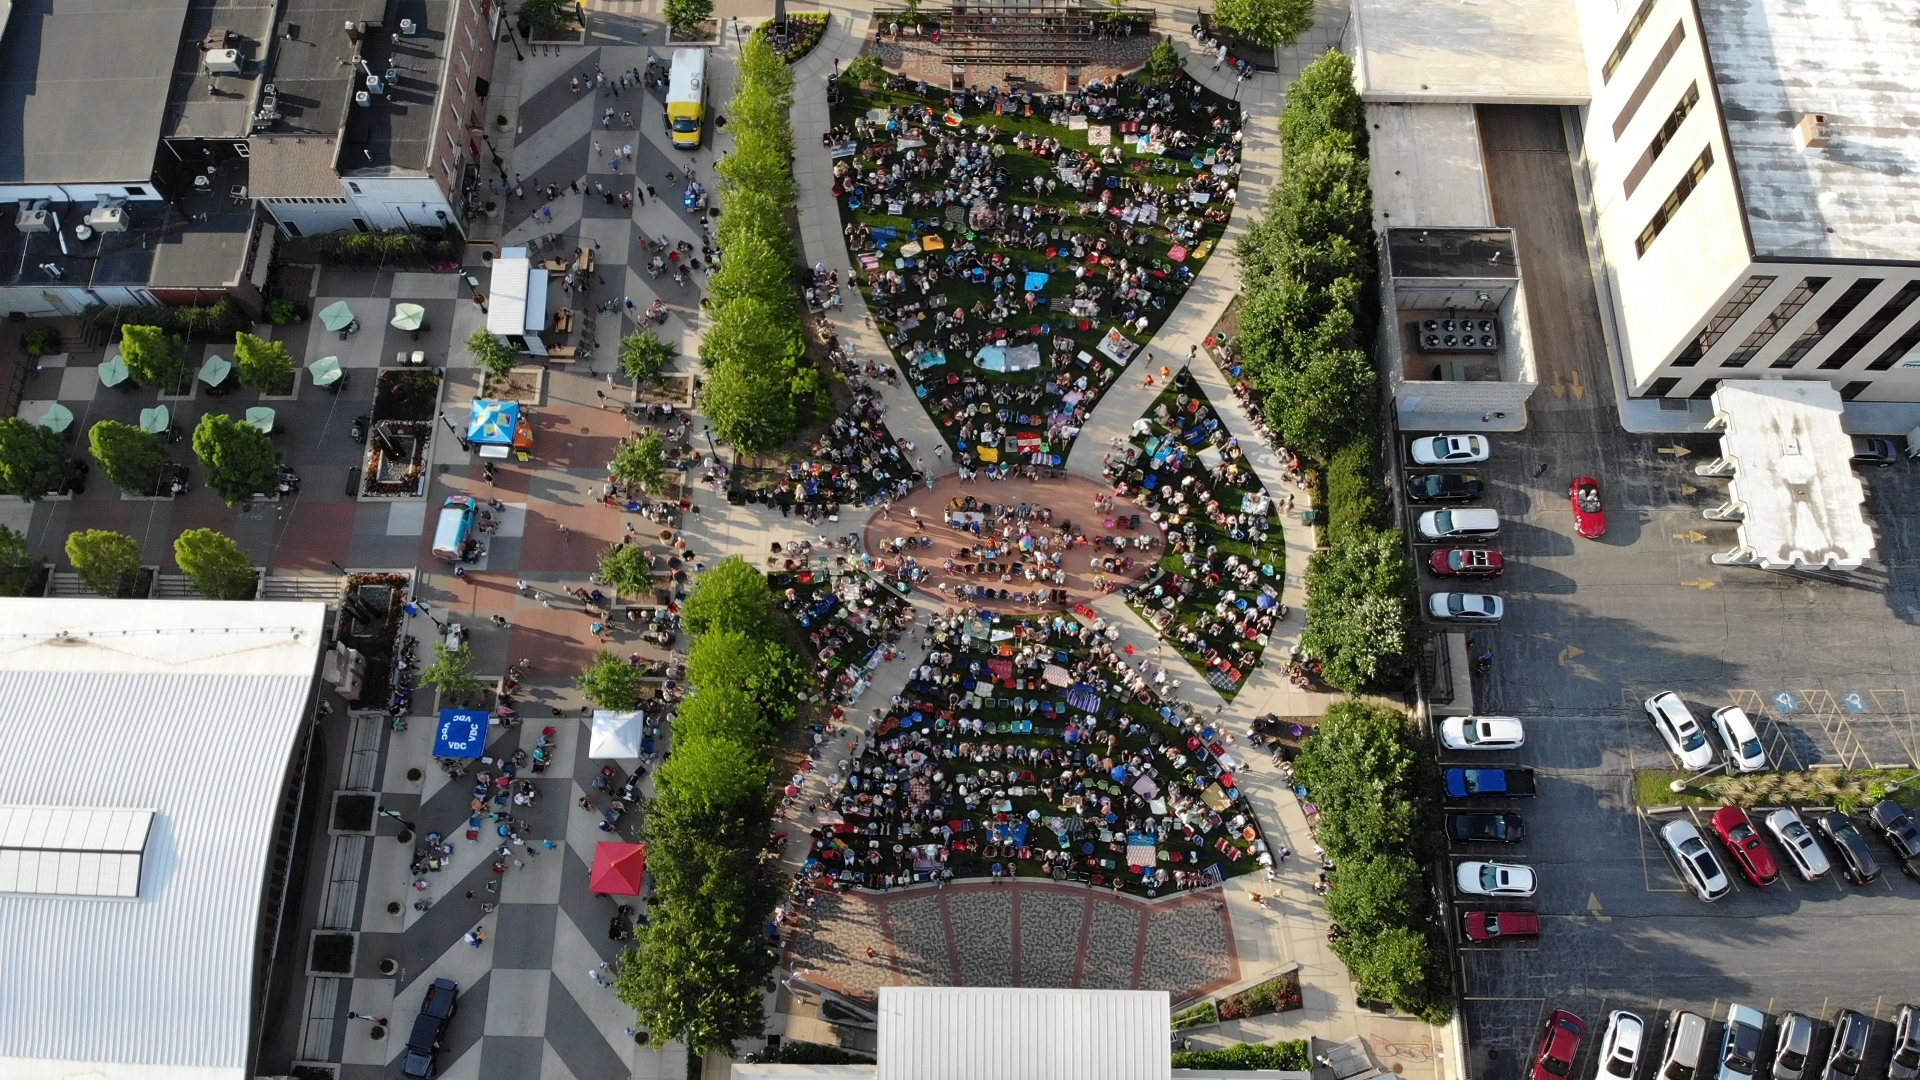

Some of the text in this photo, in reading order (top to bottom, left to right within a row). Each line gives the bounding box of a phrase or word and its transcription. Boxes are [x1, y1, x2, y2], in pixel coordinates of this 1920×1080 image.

[441, 722, 451, 741] VDC
[468, 723, 478, 742] VDC
[448, 741, 467, 750] VDC
